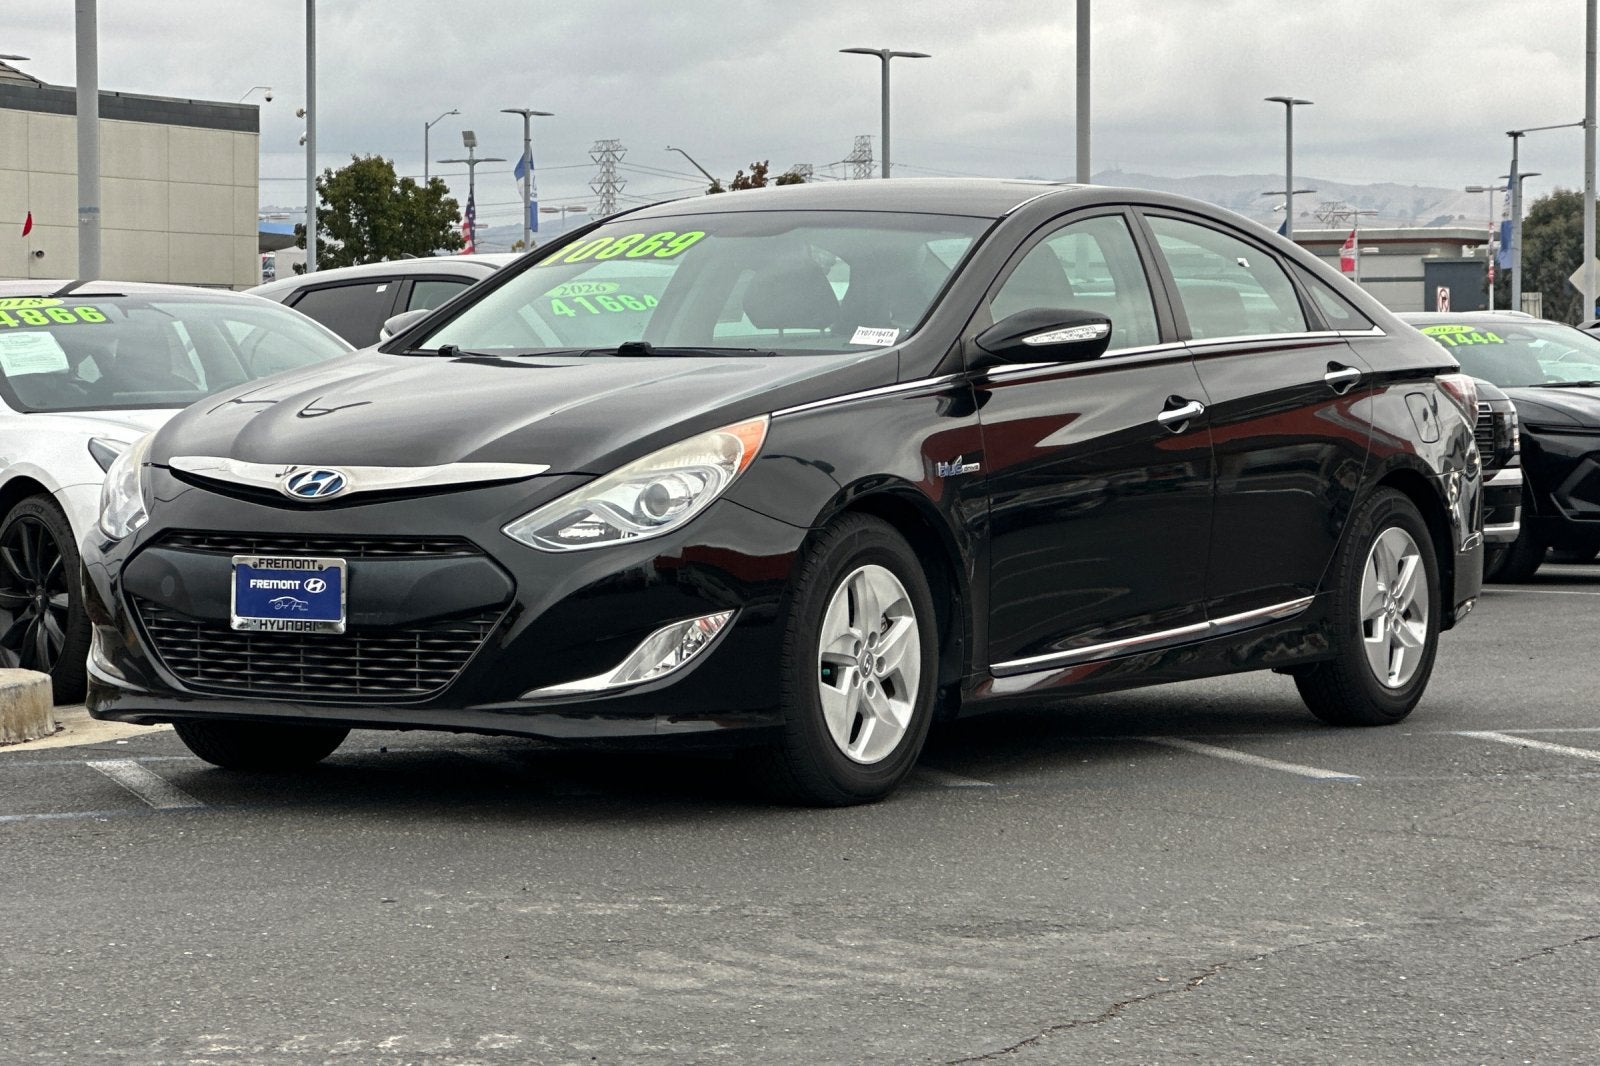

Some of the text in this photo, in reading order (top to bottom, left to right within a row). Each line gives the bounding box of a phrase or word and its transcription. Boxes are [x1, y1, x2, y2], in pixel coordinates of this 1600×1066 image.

[540, 231, 706, 267] 10869
[551, 294, 658, 317] 41664
[0, 306, 106, 327] 4866
[258, 558, 318, 570] FREMONT
[249, 579, 301, 590] FREMONT
[259, 619, 316, 631] HYUNDAI
